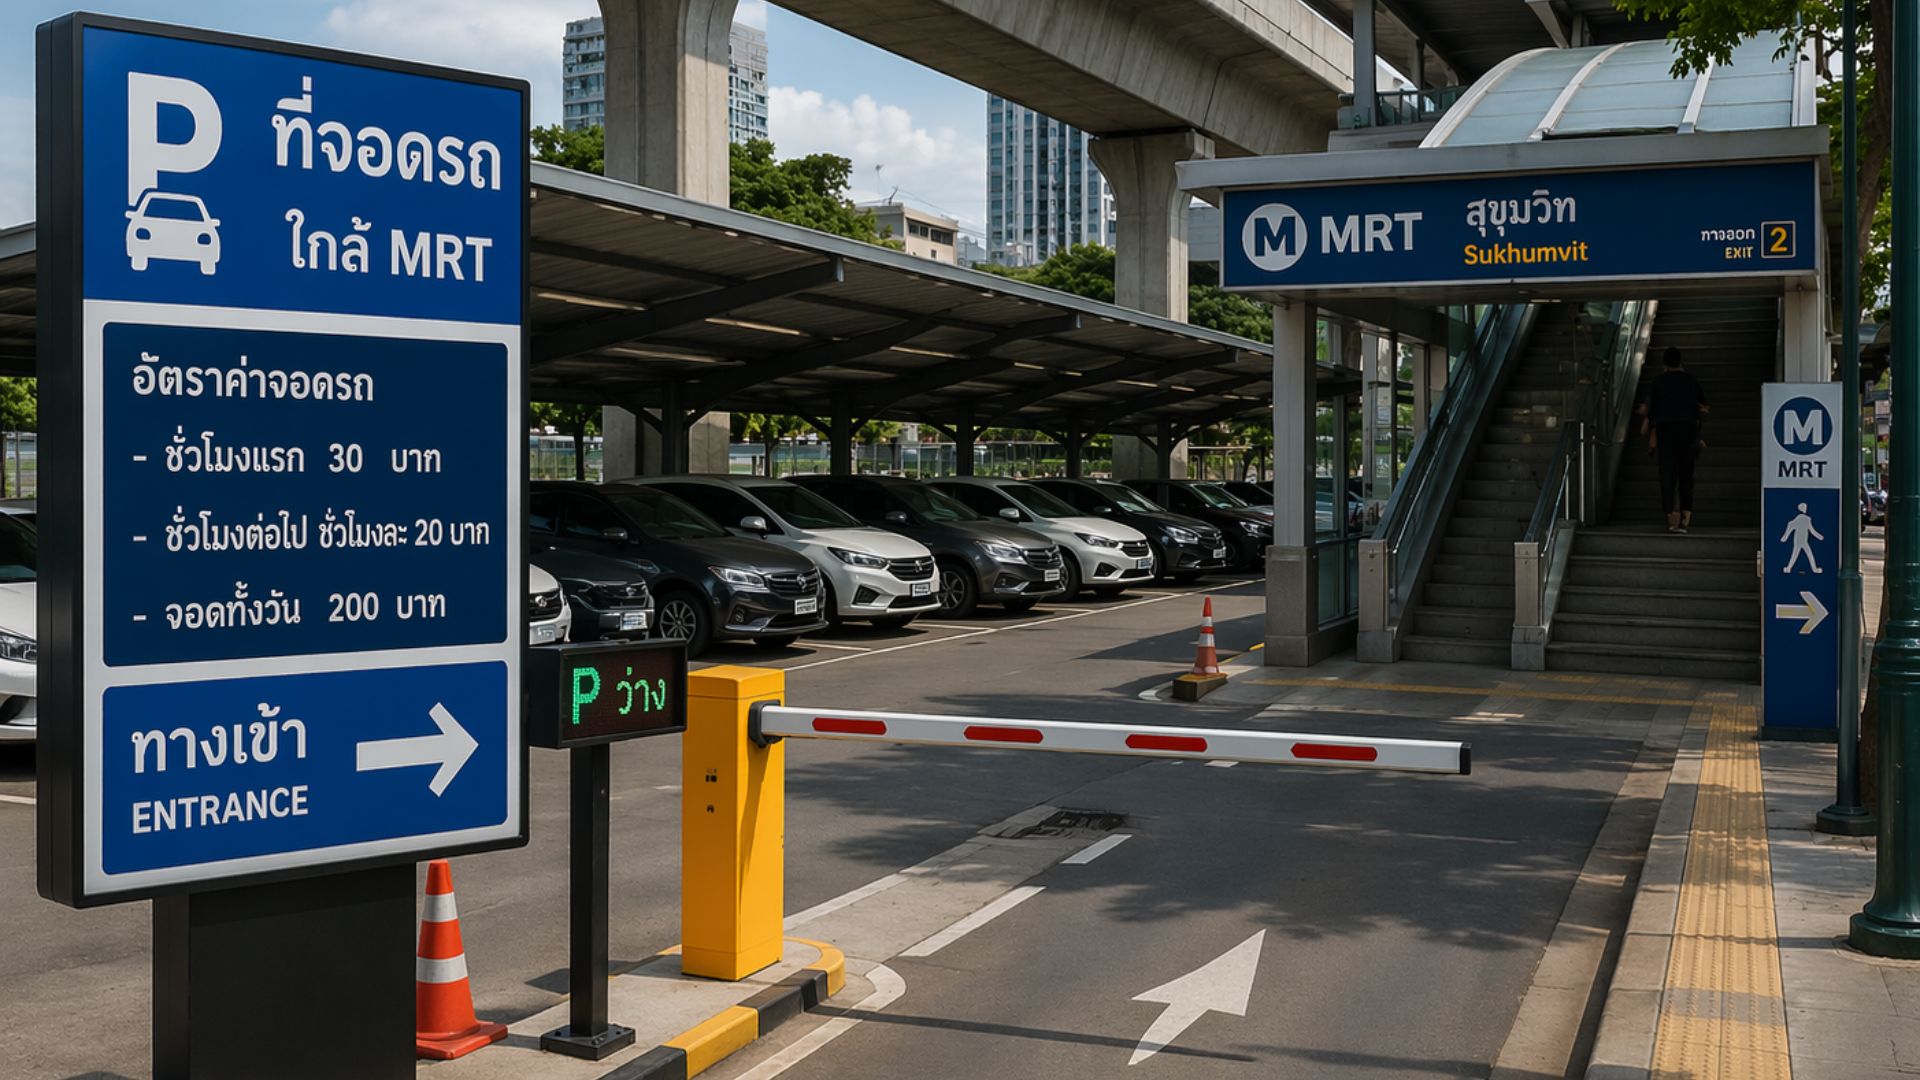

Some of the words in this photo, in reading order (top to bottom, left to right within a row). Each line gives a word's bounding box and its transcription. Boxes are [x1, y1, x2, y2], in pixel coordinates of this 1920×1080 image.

[128, 72, 222, 206] P
[272, 75, 501, 190] ที่จอดรถ
[1322, 212, 1422, 253] MRT
[1467, 190, 1575, 237] สุขุมวิท
[285, 209, 371, 273] ใกล้
[391, 229, 492, 281] MRT
[1465, 241, 1588, 264] Sukhumvit
[1726, 247, 1753, 258] EXIT
[1771, 227, 1787, 252] 2
[134, 352, 373, 400] อัตราค่าจอดรถ
[166, 426, 304, 472] ชั่วโมงแรก
[329, 443, 362, 472] 30
[1779, 461, 1827, 478] MRT
[319, 508, 407, 548] ชั่วโมงละ
[415, 519, 442, 545] 20
[166, 581, 300, 629] จอดทั้งวัน
[329, 592, 379, 622] 200
[397, 594, 445, 619] บาท
[573, 667, 600, 724] P
[617, 667, 665, 714] ว่าง
[132, 703, 306, 773] ทางเข้า
[133, 785, 308, 833] ENTRANCE
